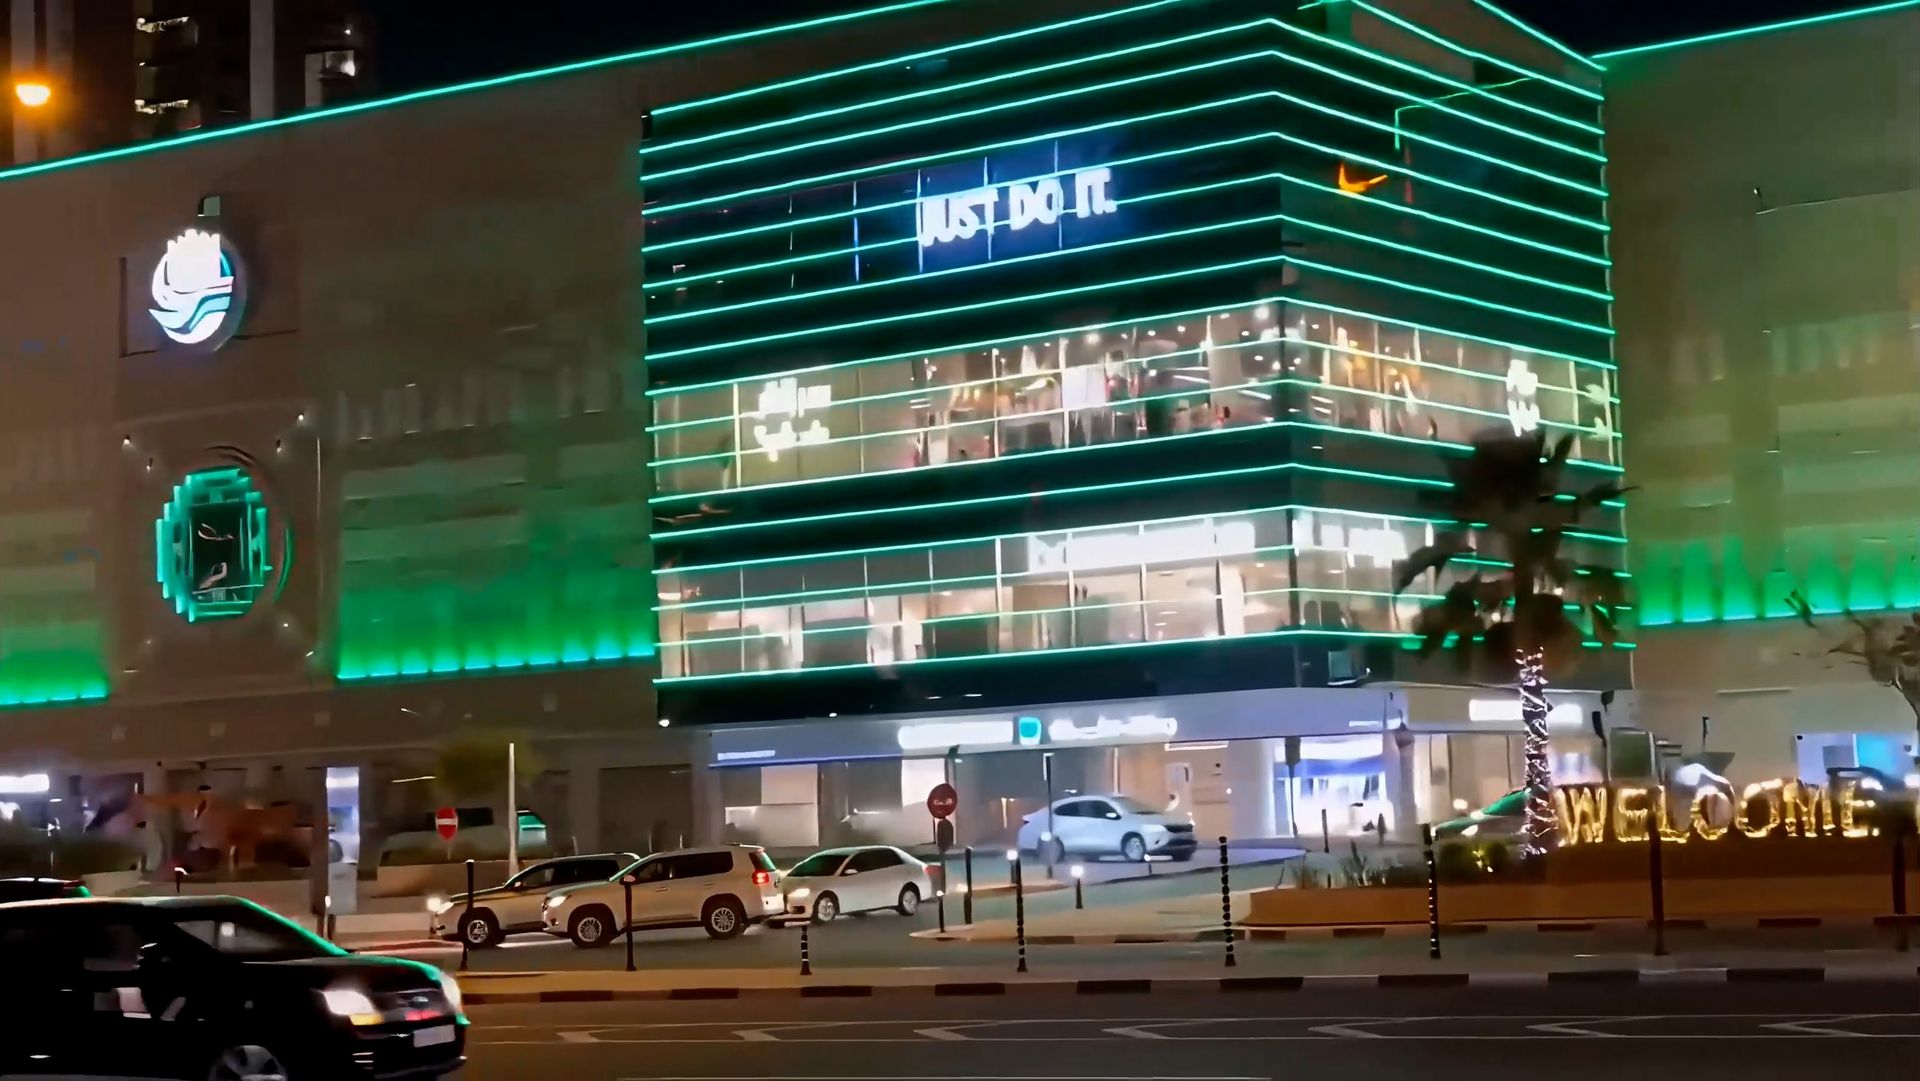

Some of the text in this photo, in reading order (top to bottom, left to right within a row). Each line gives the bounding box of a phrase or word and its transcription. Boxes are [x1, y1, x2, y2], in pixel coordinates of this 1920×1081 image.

[917, 168, 1117, 247] JUST DO IT.
[1554, 778, 1880, 846] WELCOME
